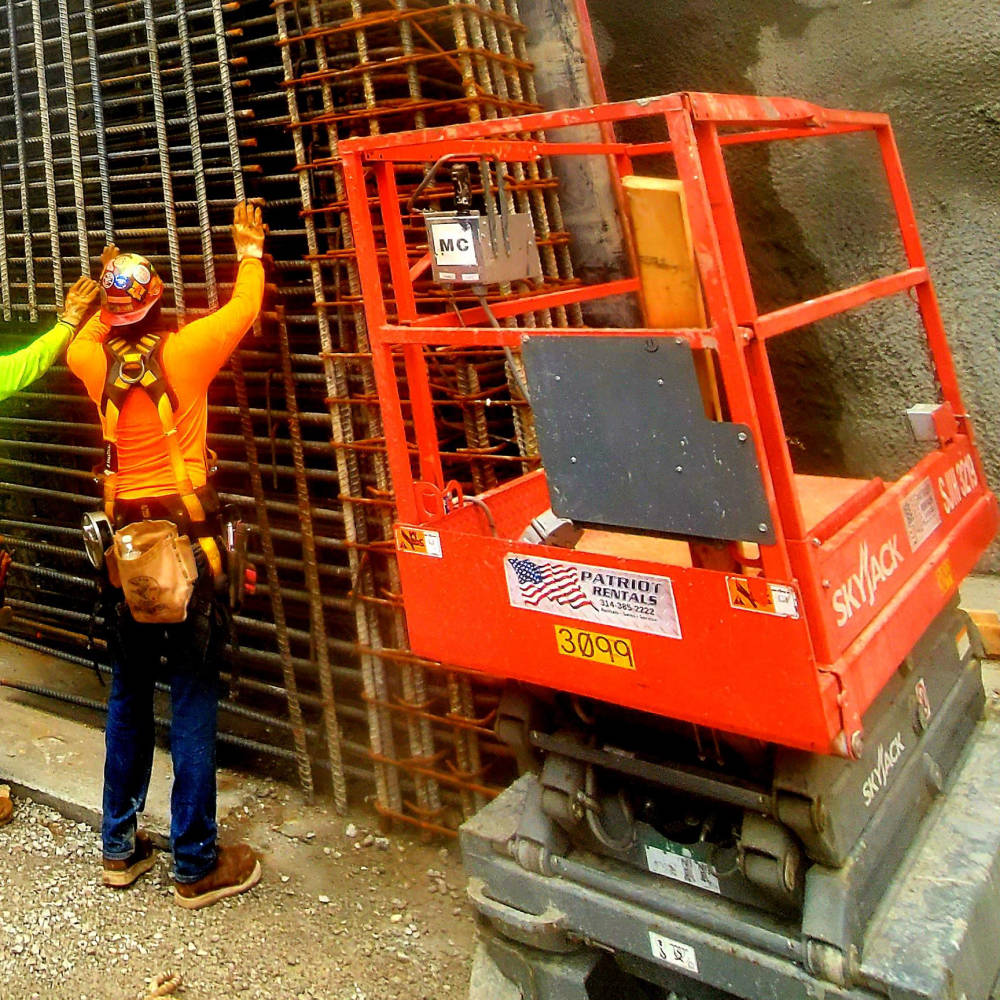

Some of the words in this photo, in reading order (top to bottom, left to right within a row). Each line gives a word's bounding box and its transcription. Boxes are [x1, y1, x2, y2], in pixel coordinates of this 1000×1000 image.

[439, 238, 469, 252] MC
[580, 570, 661, 594] PATRIOT
[832, 534, 904, 628] SKYJACK
[592, 586, 658, 606] RENTALS
[600, 599, 656, 616] 314-385-2222
[862, 732, 905, 808] SKYJACK
